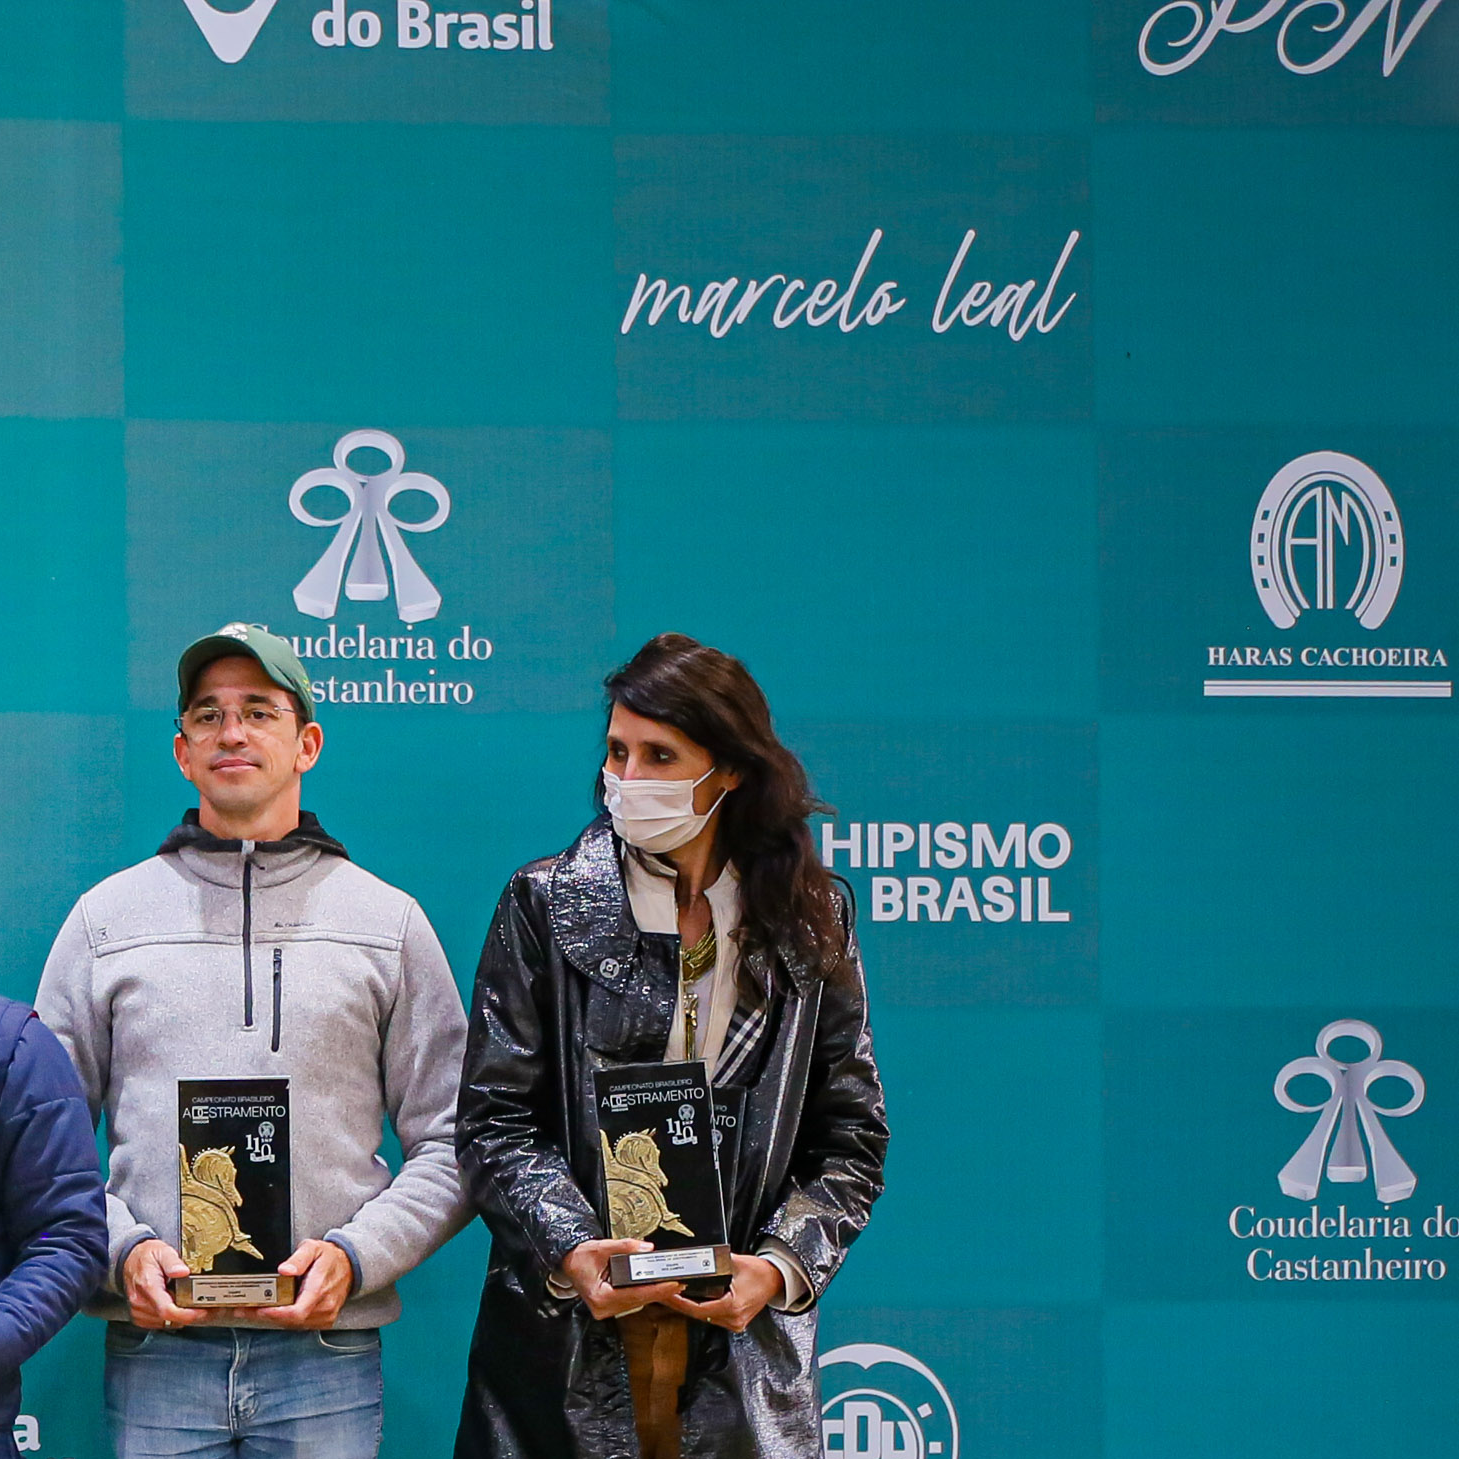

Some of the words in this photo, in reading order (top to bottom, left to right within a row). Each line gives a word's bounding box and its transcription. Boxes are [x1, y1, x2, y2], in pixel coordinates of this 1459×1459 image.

[312, 0, 382, 48] do
[397, 0, 554, 51] Brasil
[621, 227, 906, 339] marcelo
[932, 228, 1080, 342] leal
[252, 623, 437, 661] udelaria
[447, 624, 493, 660] do
[1207, 646, 1293, 666] HARAS
[1300, 646, 1448, 667] CACHOEIRA
[309, 666, 474, 705] stanheiro
[821, 821, 1072, 870] HIPISMO
[871, 876, 1071, 923] BRASIL
[182, 1105, 286, 1121] ADESTRAMENTO
[601, 1087, 705, 1109] ADESTRAMENTO
[1228, 1204, 1412, 1238] Coudelaria
[1423, 1205, 1459, 1238] do
[1246, 1247, 1447, 1281] Castanheiro
